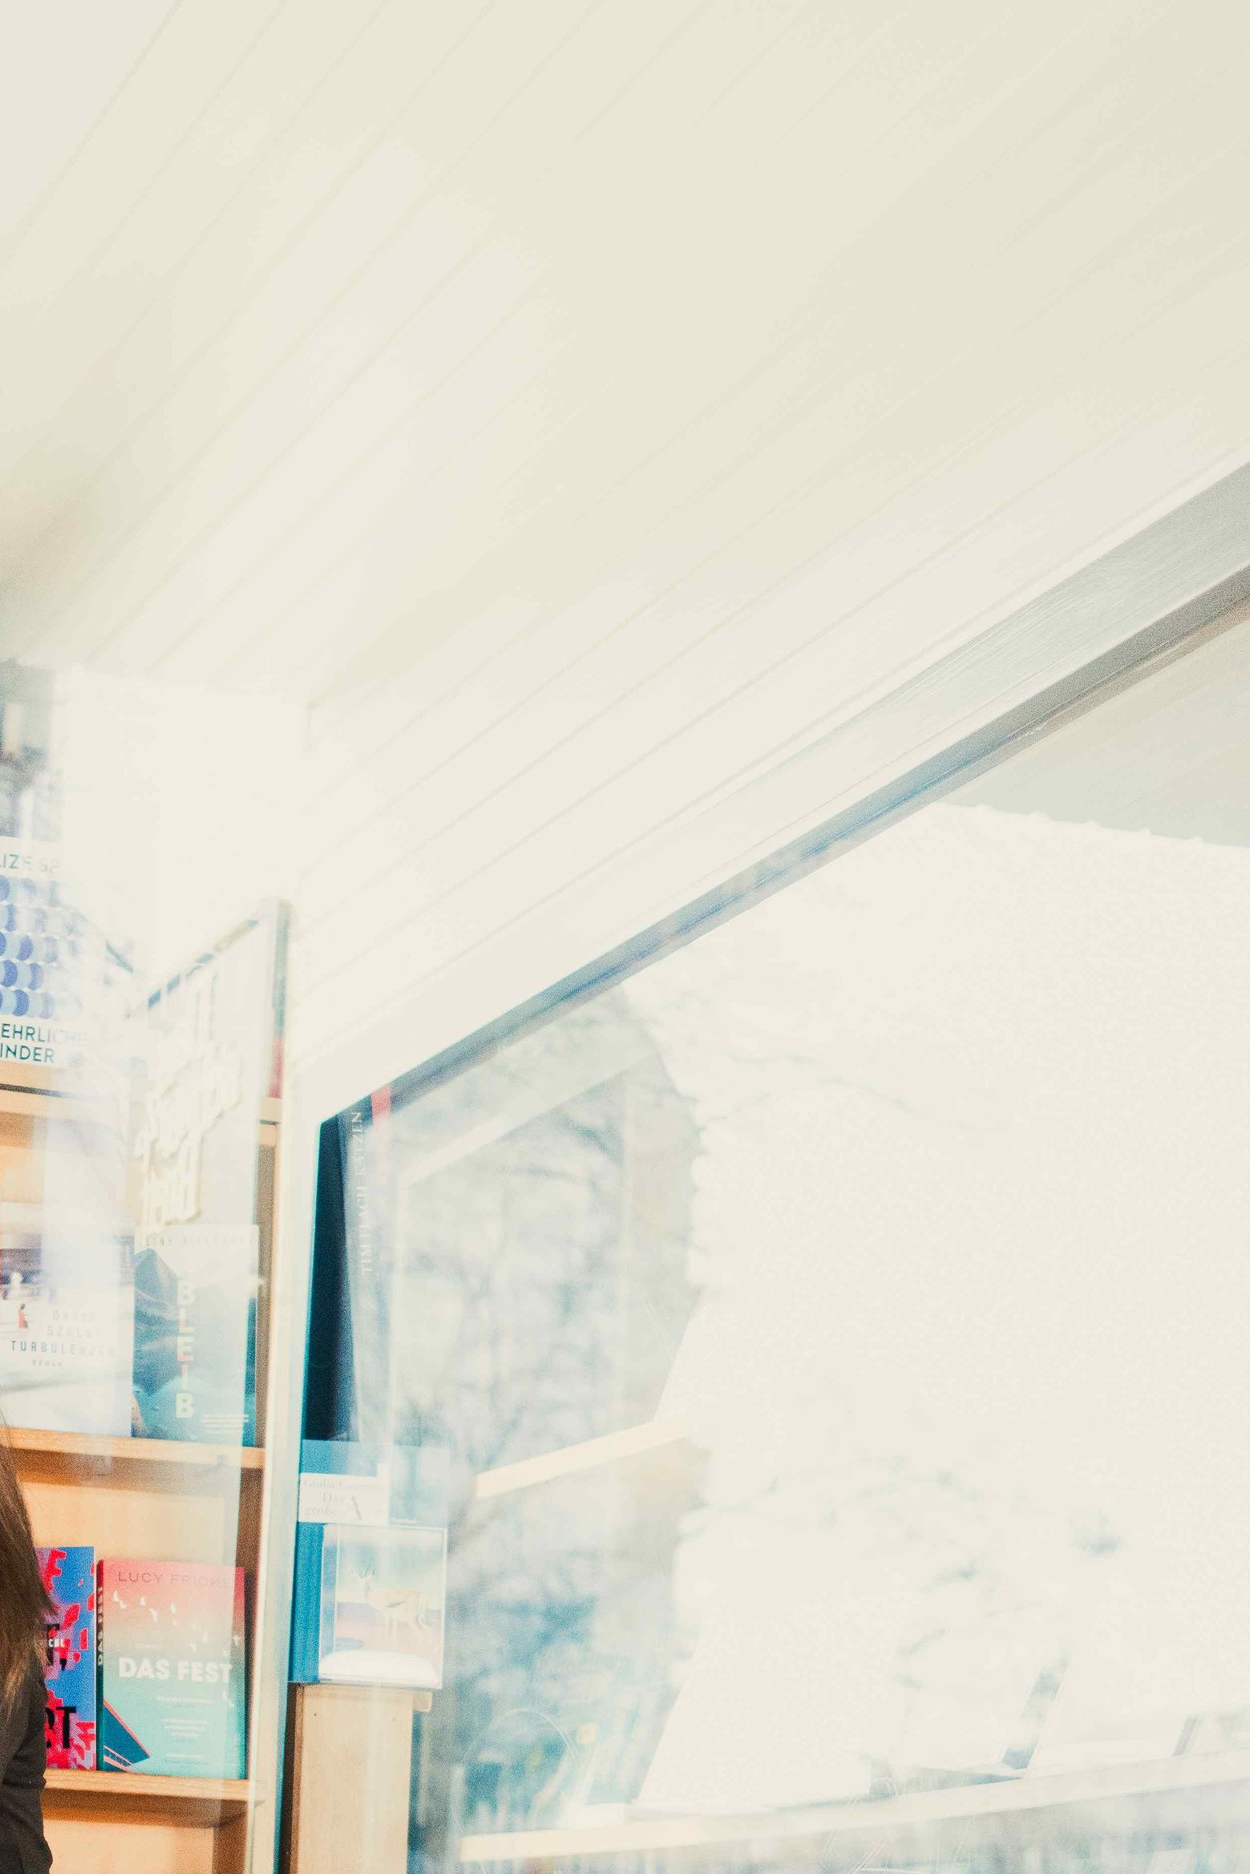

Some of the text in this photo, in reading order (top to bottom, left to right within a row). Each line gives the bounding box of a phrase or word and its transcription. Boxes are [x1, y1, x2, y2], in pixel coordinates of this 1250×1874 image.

[118, 1570, 165, 1586] LUCY
[118, 1658, 232, 1684] DAS FEST
